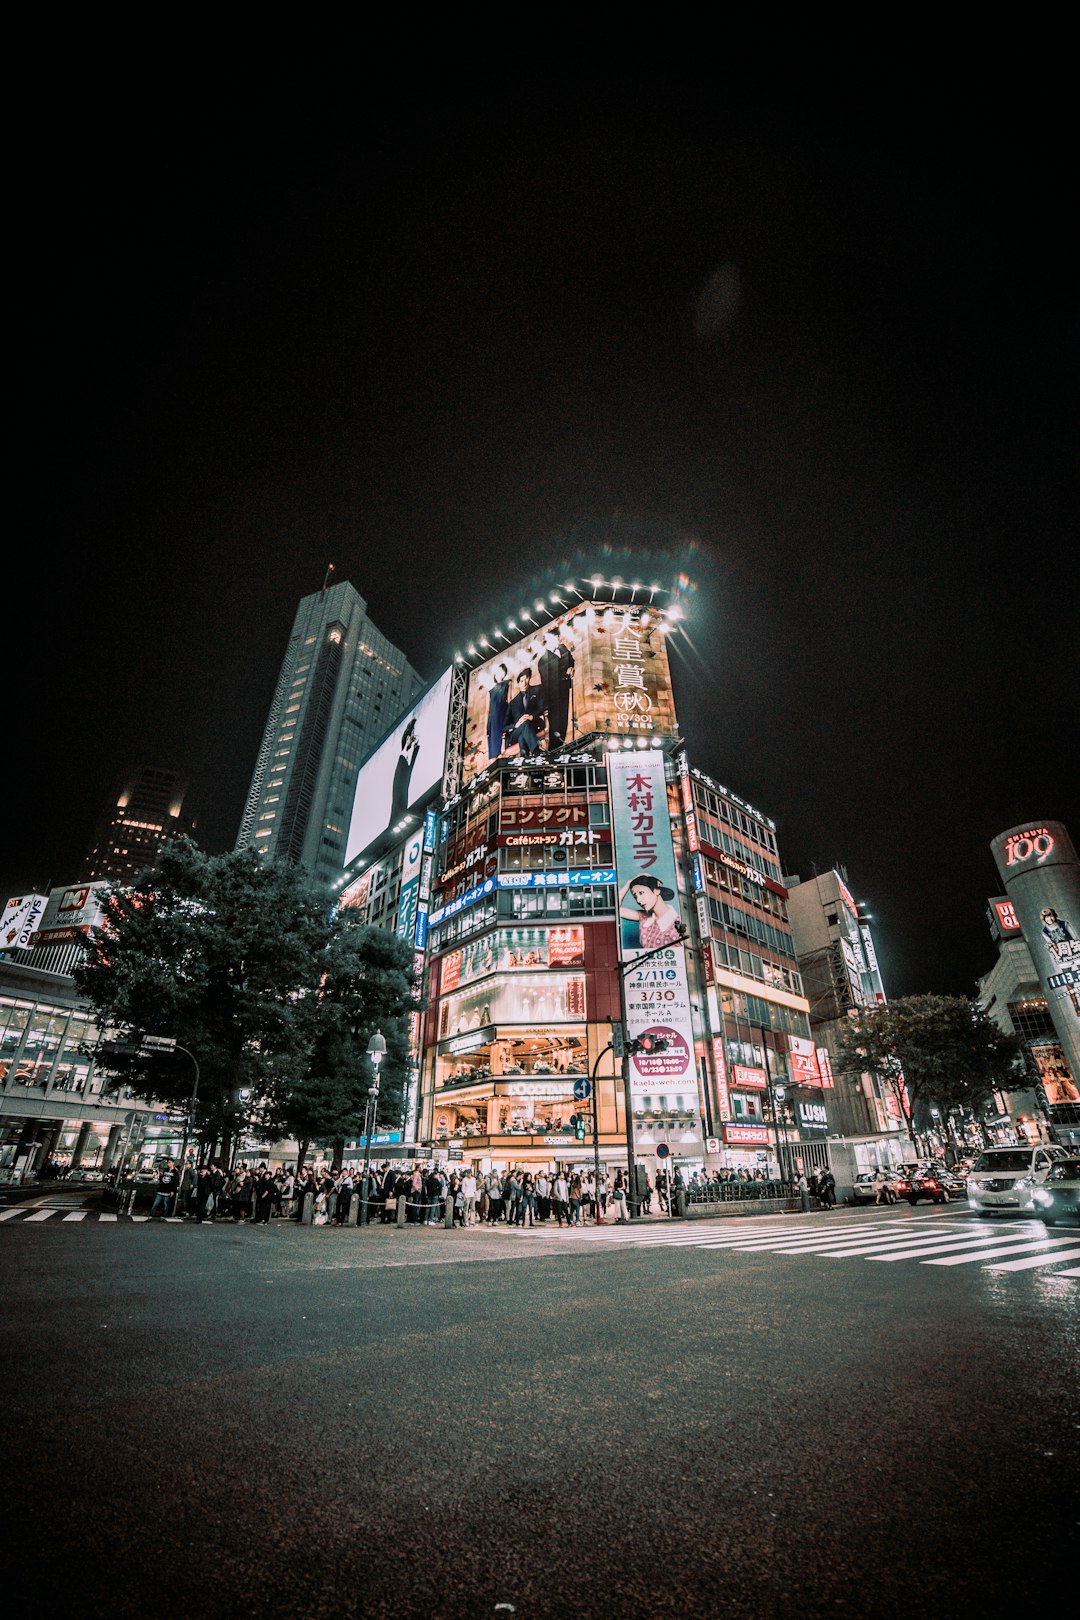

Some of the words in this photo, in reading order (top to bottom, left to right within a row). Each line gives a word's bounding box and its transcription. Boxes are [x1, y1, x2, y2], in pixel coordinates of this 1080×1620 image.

[501, 807, 586, 825] コンタクト
[626, 773, 658, 869] 木村カエラ
[559, 830, 601, 846] ガスト
[1007, 828, 1049, 844] SHIBUYA
[1005, 834, 1055, 866] 109
[534, 872, 614, 885] 英会話イーオン
[20, 899, 42, 943] SANKYO
[629, 981, 682, 989] 神奈川県民ホール
[628, 1002, 687, 1010] 東京国際フォーラム
[796, 1055, 815, 1071] アコム
[633, 1079, 695, 1087] kaela-web.com
[799, 1103, 828, 1122] LUSH
